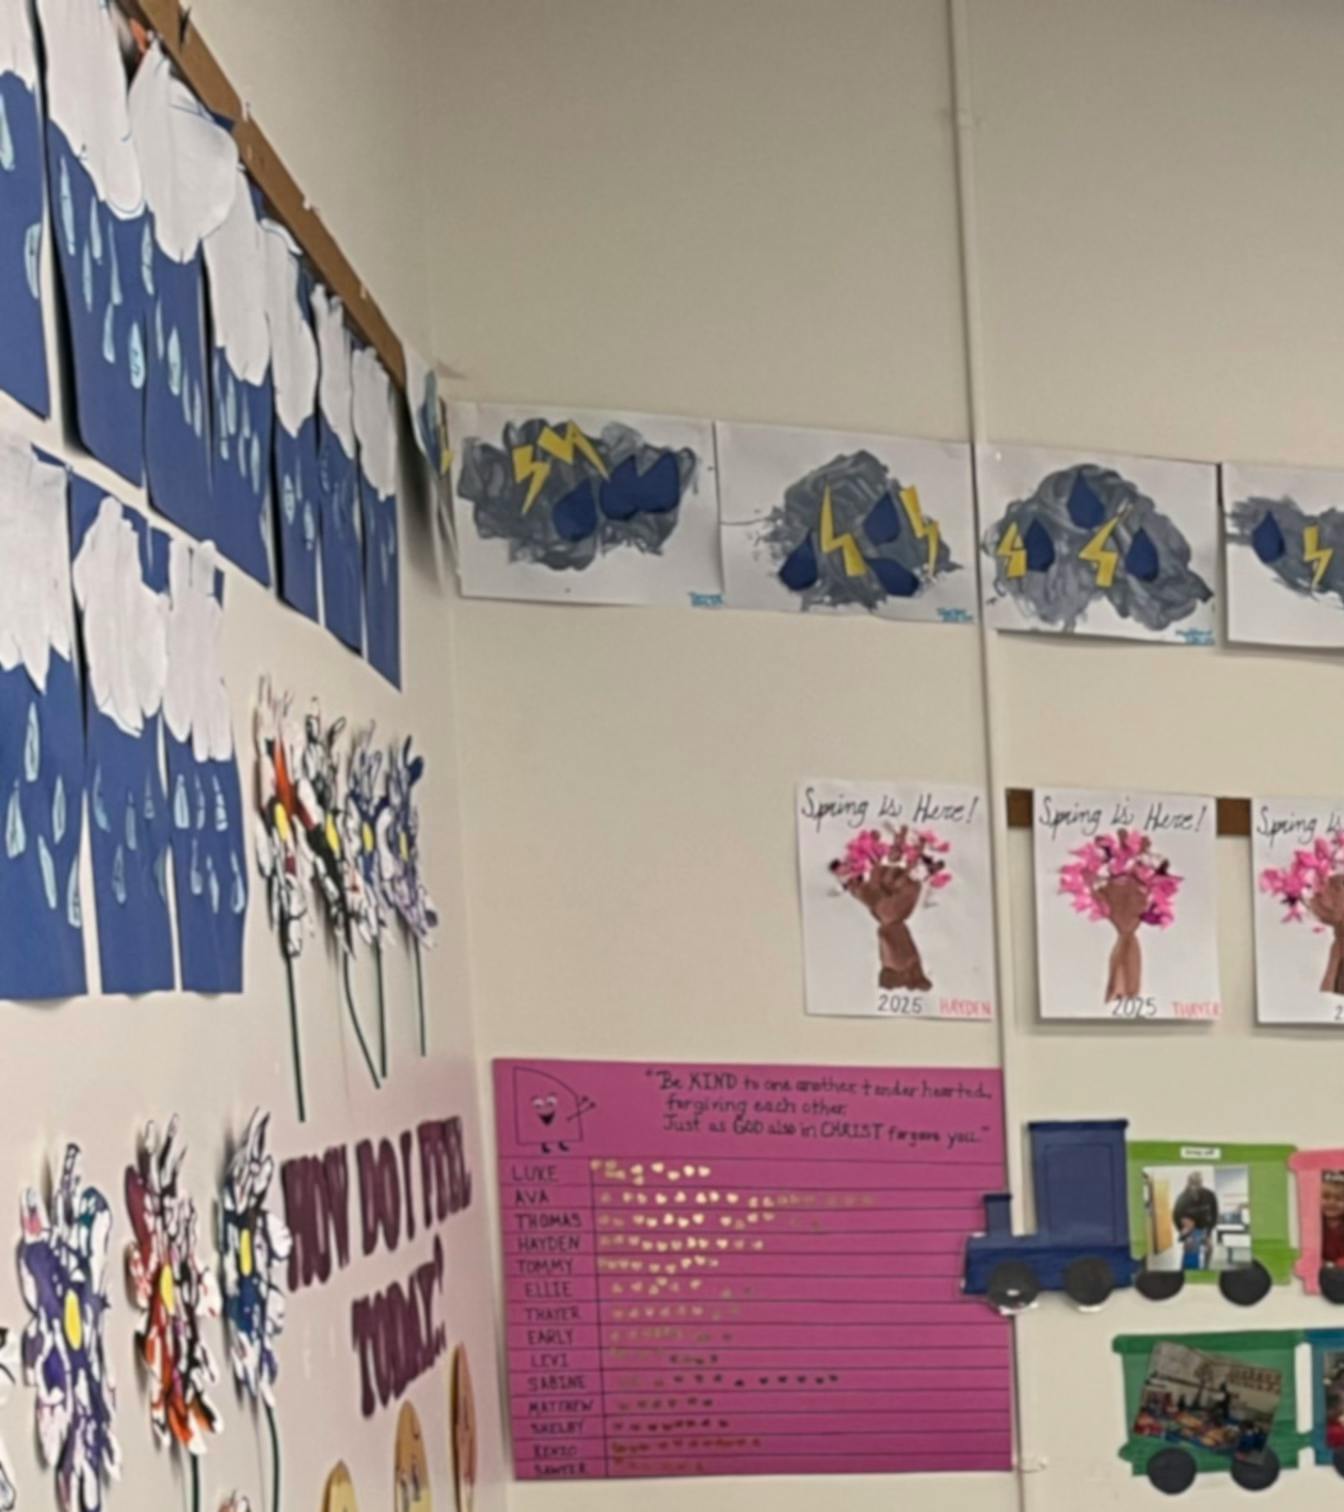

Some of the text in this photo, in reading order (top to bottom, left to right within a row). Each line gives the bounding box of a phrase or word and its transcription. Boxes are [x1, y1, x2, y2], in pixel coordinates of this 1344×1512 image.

[801, 786, 870, 833] Spring
[911, 791, 980, 824] Here!
[1038, 795, 1103, 842] Spring
[1143, 801, 1208, 833] Here!
[877, 994, 923, 1014] 2025
[1111, 997, 1158, 1017] 2025
[688, 1071, 738, 1091] KIND
[665, 1091, 748, 1116] forgiving
[752, 1094, 798, 1115] each
[708, 1121, 726, 1134] as
[731, 1115, 765, 1136] GOD
[820, 1121, 884, 1141] CHRIST
[511, 1164, 559, 1182] LUKE
[514, 1187, 551, 1205] AVA
[514, 1210, 583, 1230] THOMAS
[517, 1235, 581, 1252] HAYDEN
[515, 1257, 574, 1275] TOMMY
[524, 1280, 575, 1298] ELLIE
[526, 1328, 575, 1347] EARLY
[530, 1352, 571, 1369] LEVI
